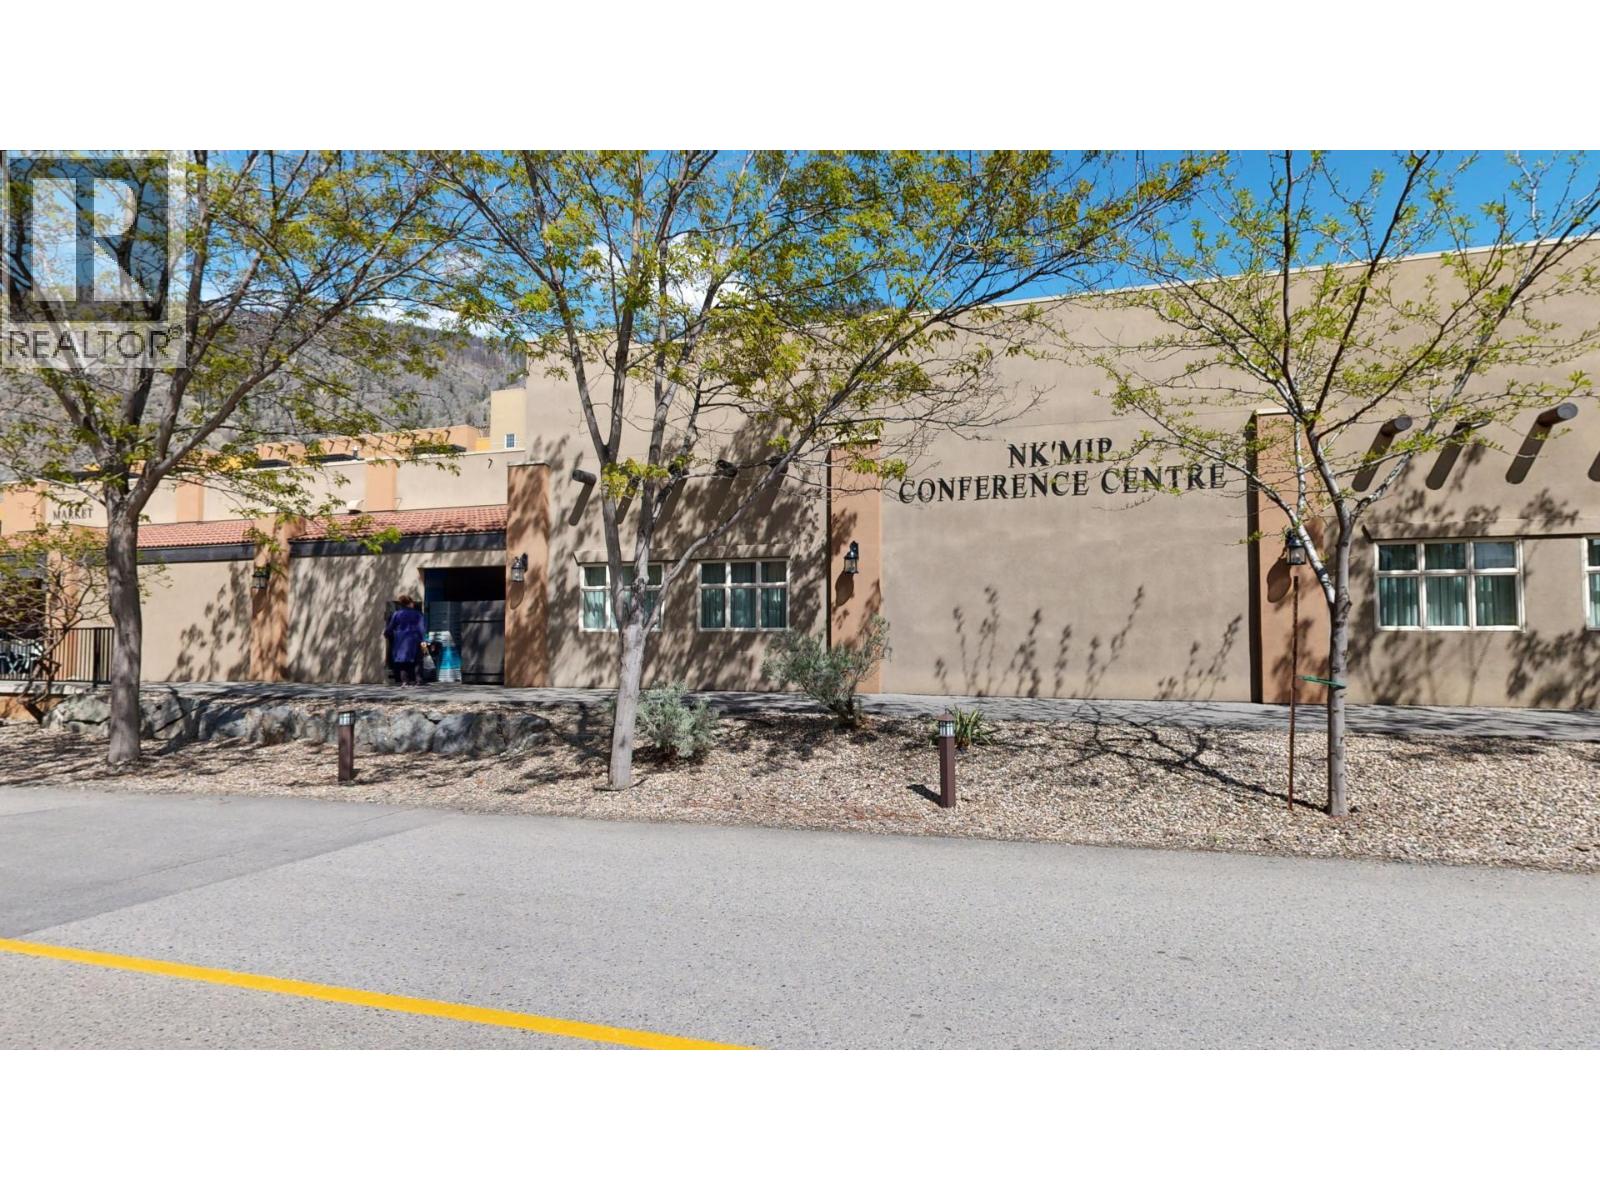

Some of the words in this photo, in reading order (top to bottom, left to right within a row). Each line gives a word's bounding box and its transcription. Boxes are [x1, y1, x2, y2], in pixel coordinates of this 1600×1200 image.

[1007, 437, 1113, 468] NK'MIP
[898, 470, 1089, 503] CONFERENCE
[1101, 463, 1227, 494] CENTRE
[52, 507, 94, 521] MARKET
